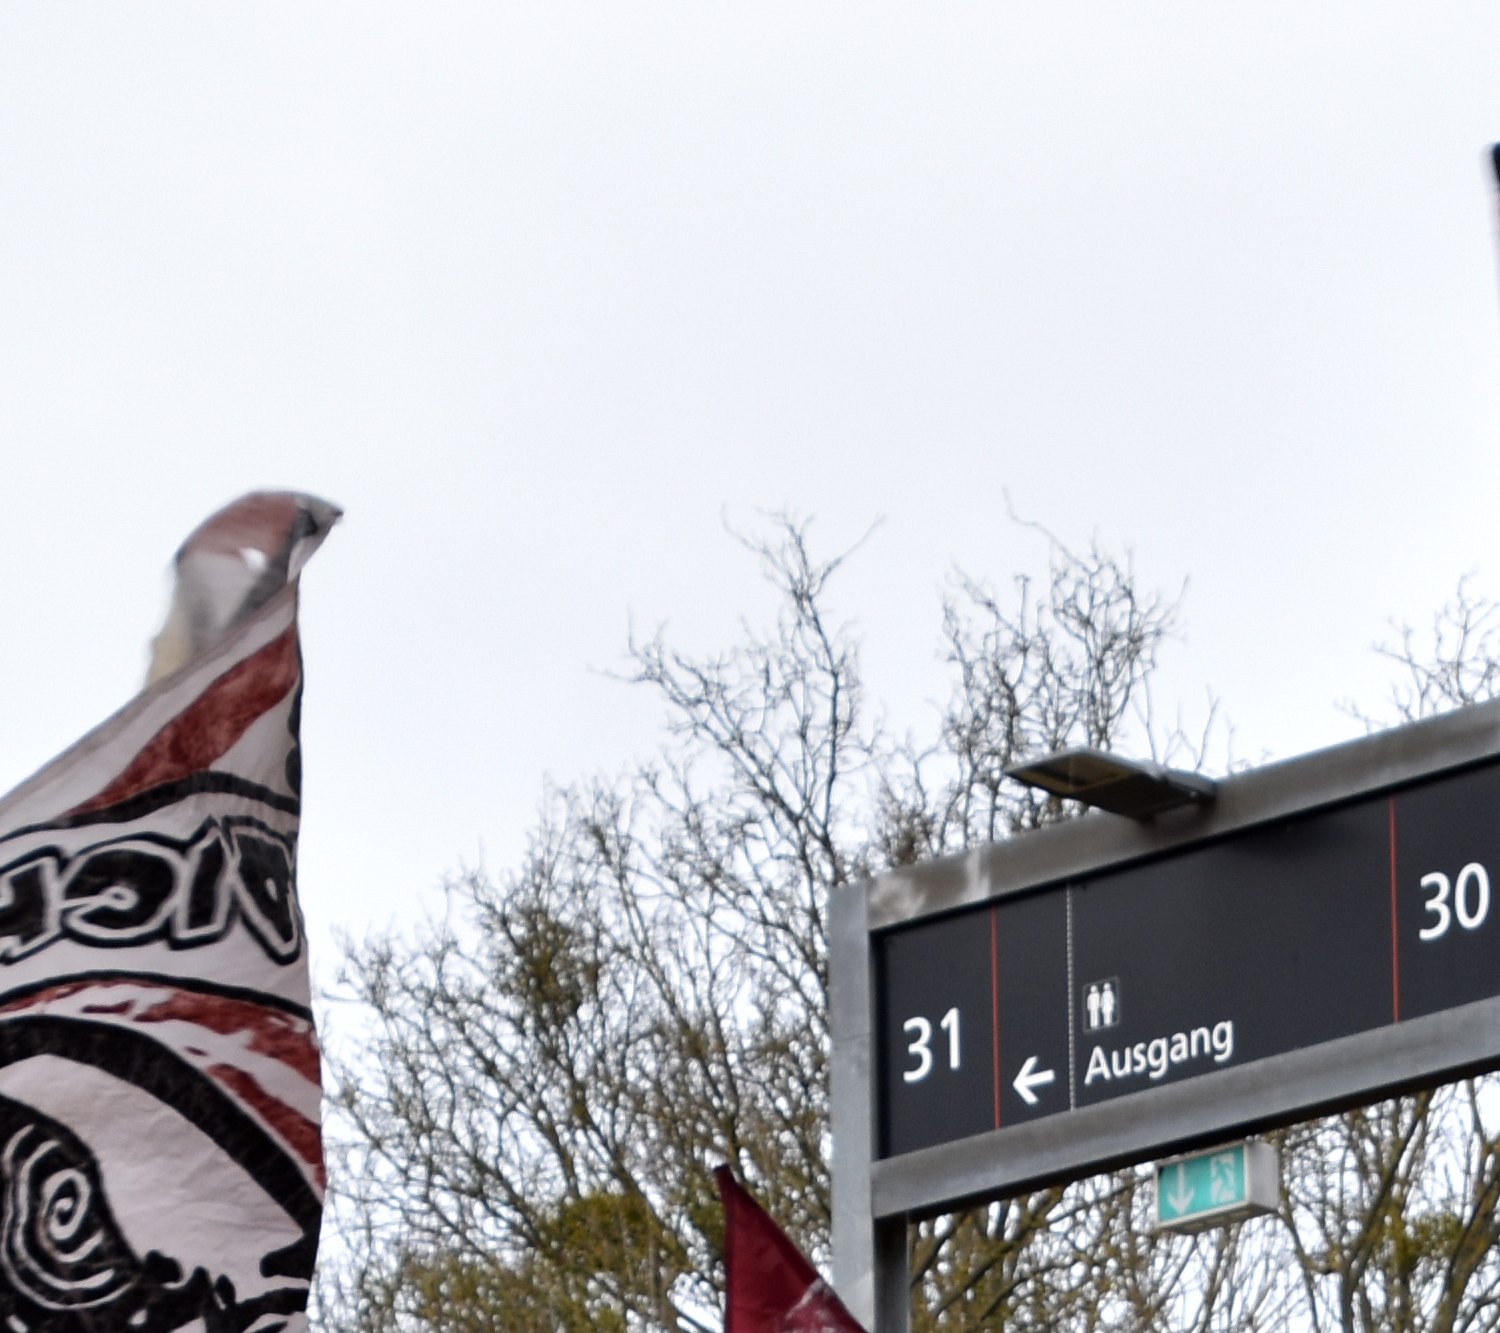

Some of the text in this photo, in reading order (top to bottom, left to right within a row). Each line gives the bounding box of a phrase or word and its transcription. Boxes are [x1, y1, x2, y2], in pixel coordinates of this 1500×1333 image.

[1419, 861, 1491, 942] 30
[903, 1006, 962, 1083] 31
[1084, 1019, 1235, 1086] Ausgang
